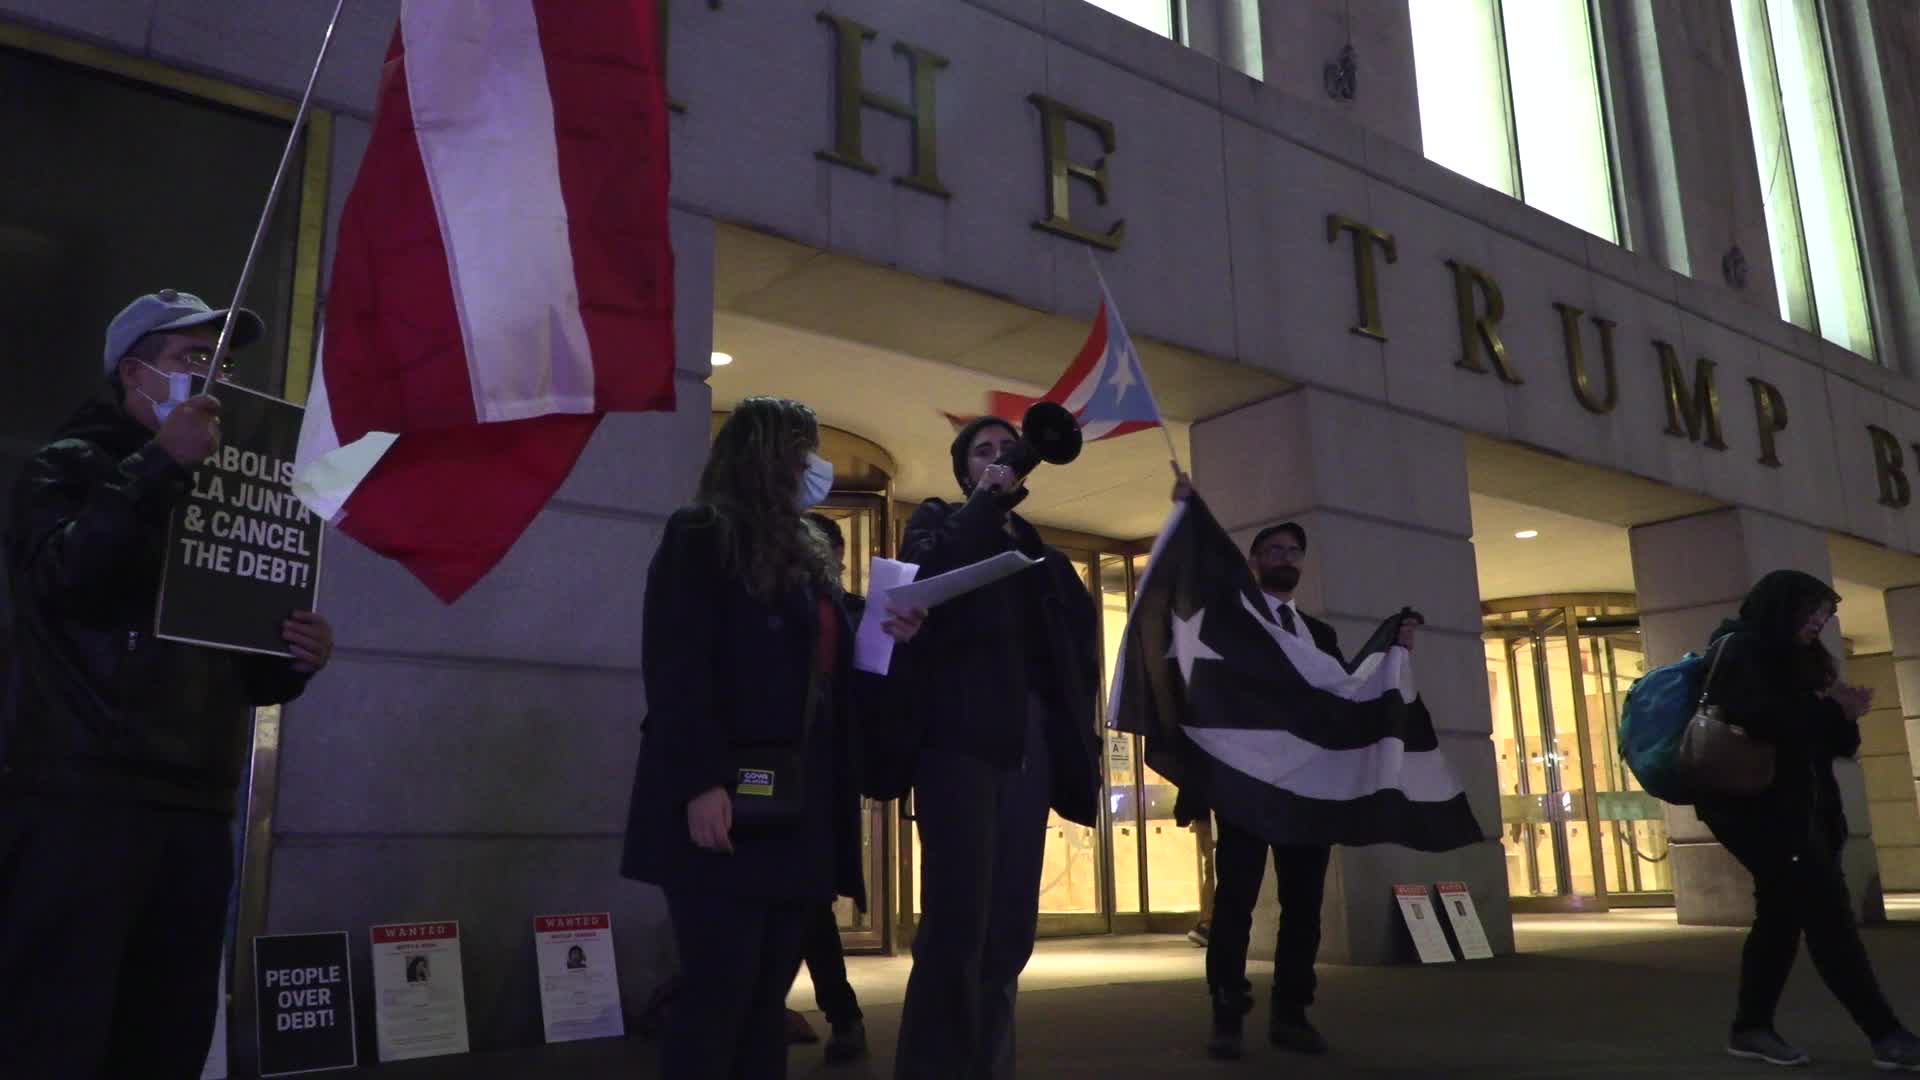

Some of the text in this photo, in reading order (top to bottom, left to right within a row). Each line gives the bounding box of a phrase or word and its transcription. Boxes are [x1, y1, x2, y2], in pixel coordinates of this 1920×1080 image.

[661, 0, 1920, 509] HE TRUMP B
[203, 445, 297, 487] ABOLIS
[191, 471, 311, 525] LA JUNTA
[184, 504, 310, 557] & CANCEL
[180, 538, 310, 588] THE DEBT!
[384, 924, 446, 938] WANTED
[544, 916, 600, 929] WANTED
[265, 965, 342, 988] PEOPLE
[277, 988, 332, 1009] OVER
[276, 1008, 335, 1032] DEBT!
